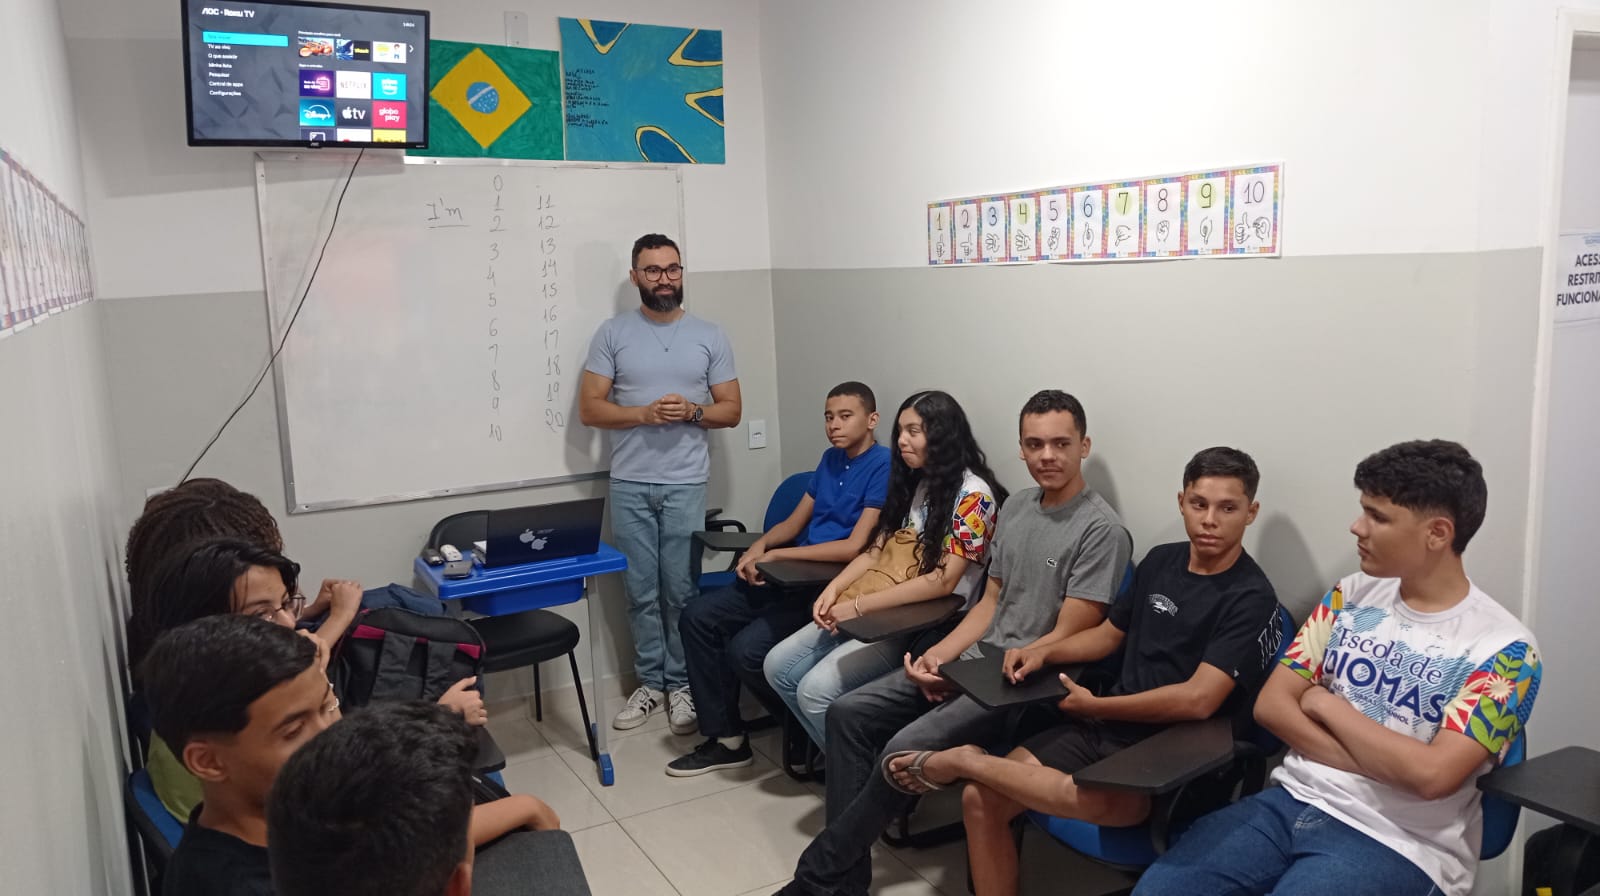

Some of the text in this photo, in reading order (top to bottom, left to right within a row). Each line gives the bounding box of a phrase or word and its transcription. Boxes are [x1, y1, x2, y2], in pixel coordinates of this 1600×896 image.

[244, 10, 255, 18] TV
[352, 108, 366, 120] tv
[493, 174, 504, 192] 0
[426, 197, 463, 221] I'm
[494, 194, 504, 212] 1
[537, 194, 556, 210] 11
[936, 180, 1265, 231] 1 2 3 4 5 6 7 8 9 10
[489, 215, 507, 232] 2
[538, 215, 560, 231] 12
[489, 242, 500, 261] 3
[541, 237, 557, 255] 13
[541, 258, 558, 278] 14
[1575, 253, 1600, 268] ACES
[486, 264, 497, 287] 4
[487, 292, 497, 308] 5
[542, 282, 558, 299] 15
[543, 304, 558, 323] 16
[488, 317, 499, 337] 6
[543, 328, 559, 350] 17
[488, 343, 499, 366] 7
[545, 354, 561, 376] 18
[491, 369, 501, 392] 8
[546, 381, 560, 402] 19
[545, 407, 565, 433] 20
[489, 423, 503, 442] 10
[1339, 628, 1442, 685] Escola de
